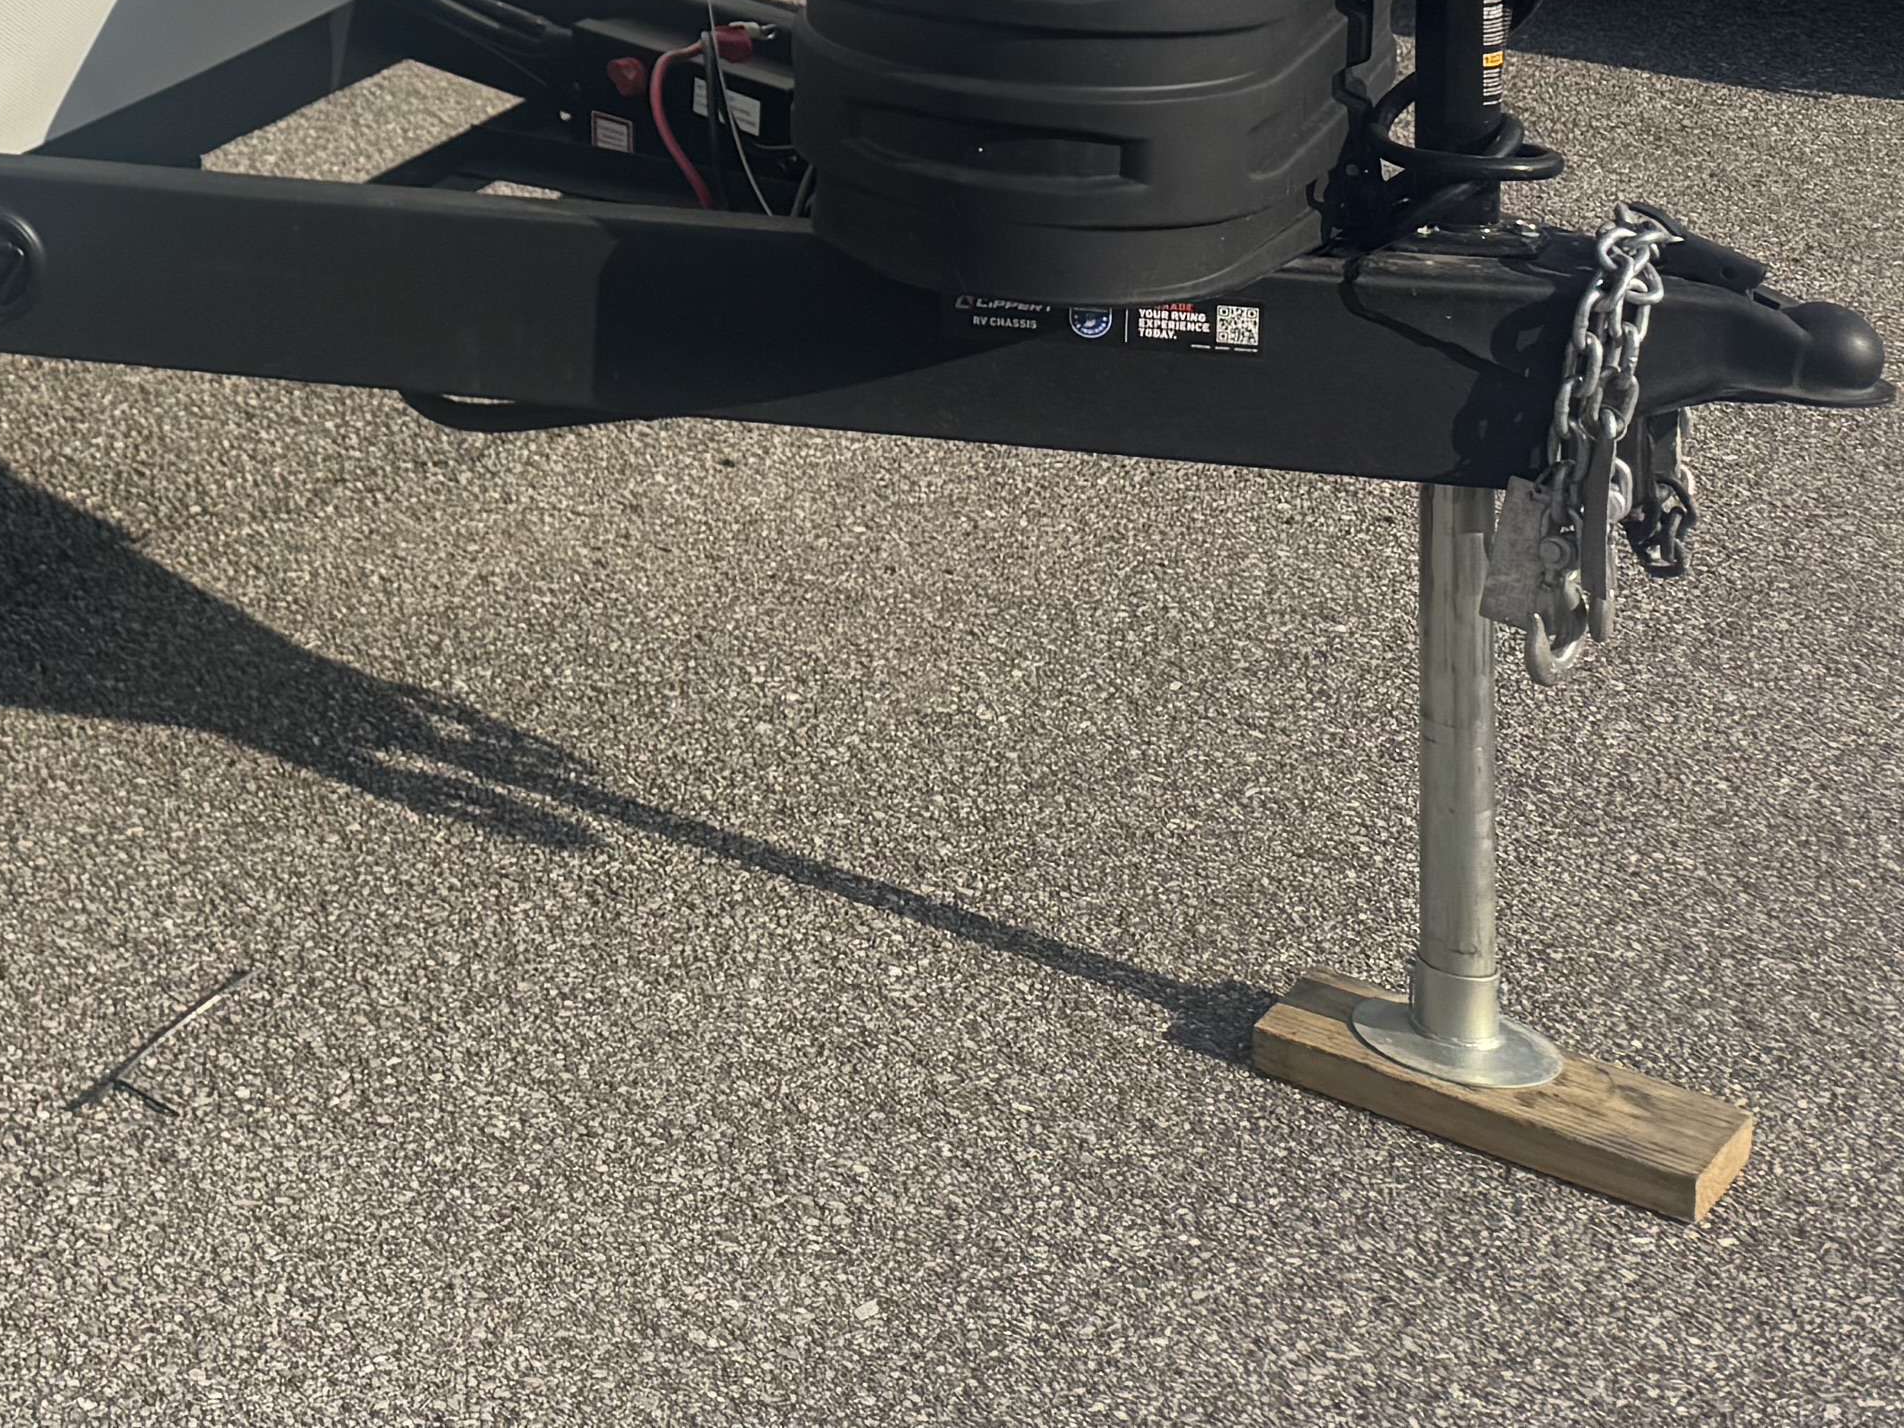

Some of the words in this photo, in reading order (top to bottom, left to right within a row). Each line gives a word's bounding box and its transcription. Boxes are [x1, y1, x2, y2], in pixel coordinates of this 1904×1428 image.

[1138, 308, 1169, 320] YOUR
[972, 315, 988, 326] RV
[990, 317, 1037, 329] CHASSIS
[1138, 318, 1210, 333] EXPERIENCE
[1138, 328, 1178, 340] TODAY.
